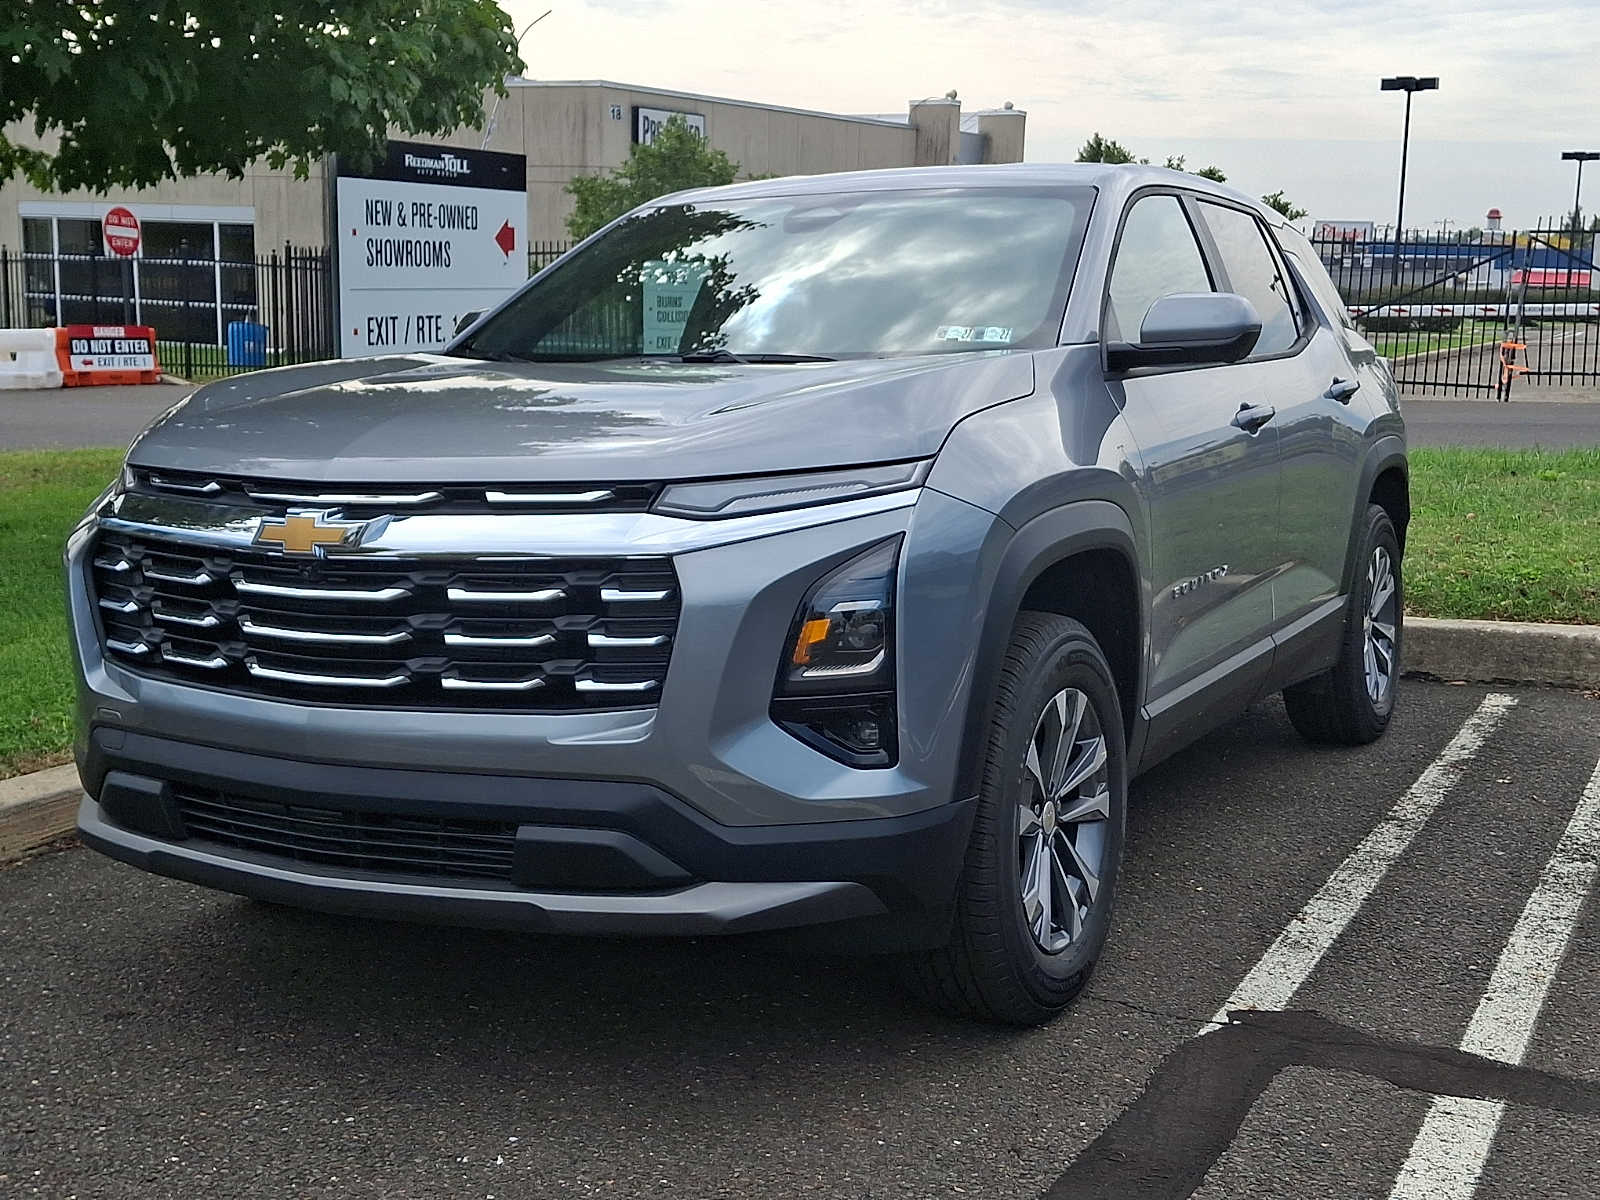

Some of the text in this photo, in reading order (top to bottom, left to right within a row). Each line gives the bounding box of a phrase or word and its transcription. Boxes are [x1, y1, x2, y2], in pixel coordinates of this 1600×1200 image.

[108, 214, 119, 225] DO
[366, 199, 478, 230] NEW & PRE-OWNED
[111, 236, 134, 248] ENTER
[366, 238, 451, 267] SHOWROOMS
[367, 316, 398, 345] EXIT
[404, 315, 411, 344] /
[416, 315, 446, 344] RTE.
[71, 339, 149, 354] DO NOT ENTER
[97, 356, 115, 367] EXIT
